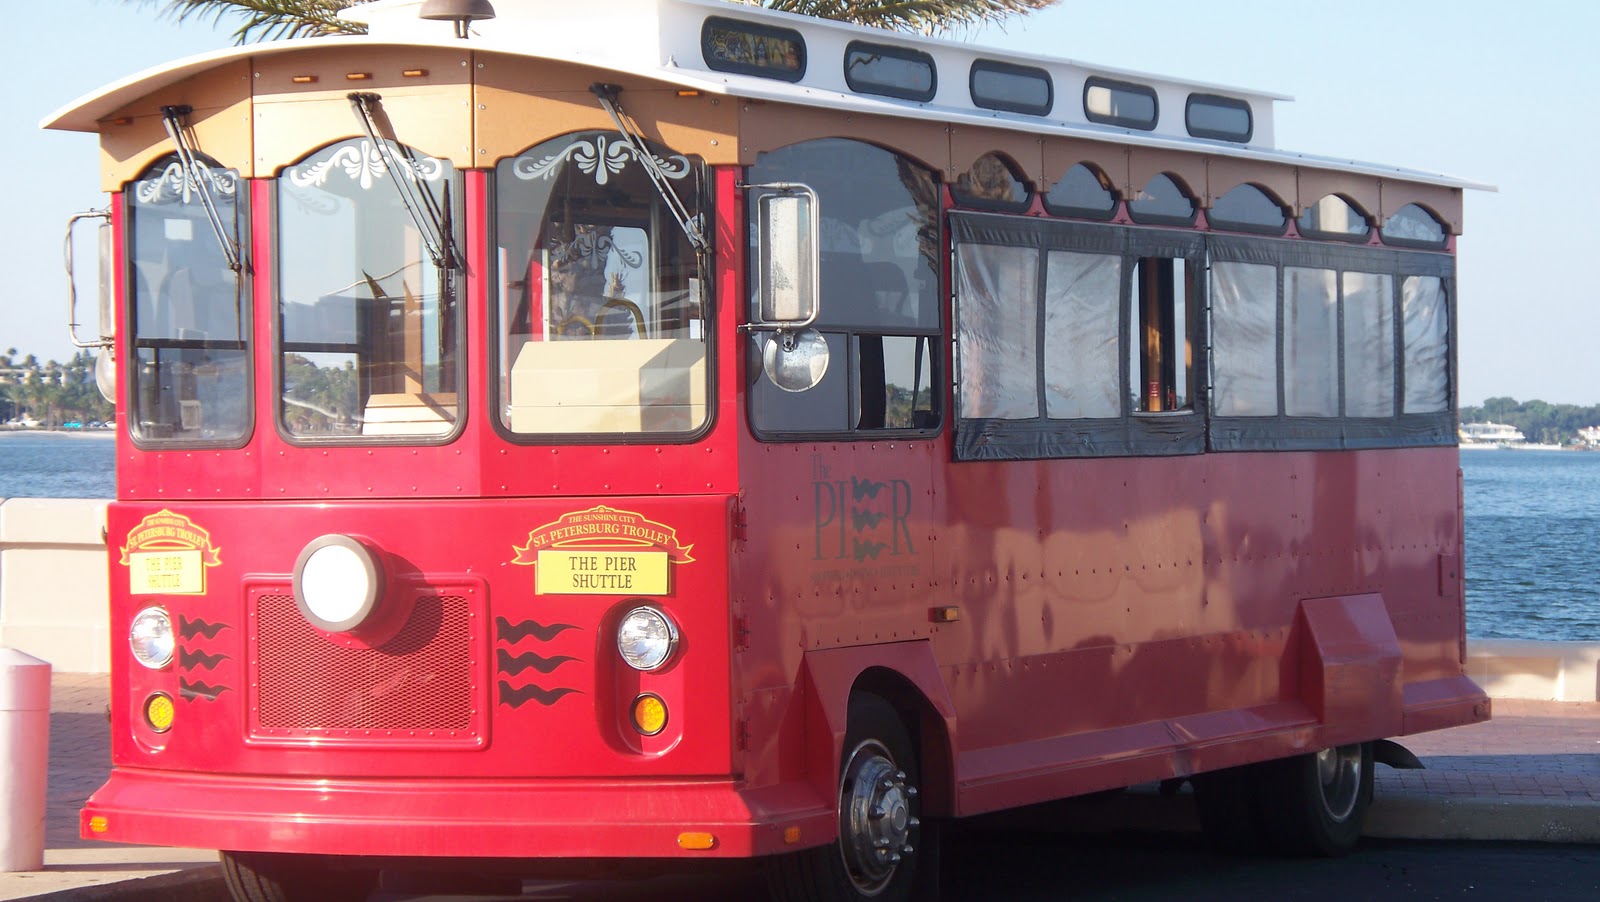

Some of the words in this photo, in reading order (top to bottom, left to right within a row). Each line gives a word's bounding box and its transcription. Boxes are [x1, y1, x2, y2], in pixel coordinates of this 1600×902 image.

[568, 516, 583, 524] THE
[583, 514, 618, 522] SUNSHINE
[618, 515, 636, 524] CITY
[138, 526, 176, 543] PETERSBURG
[176, 528, 206, 548] TROLLEY
[533, 535, 549, 548] ST.
[550, 523, 620, 542] PETERSBURG
[622, 524, 671, 545] TROLLEY
[145, 557, 161, 571] THE
[164, 556, 183, 571] PIER
[568, 556, 598, 571] THE
[604, 556, 637, 572] PIER
[148, 574, 181, 588] SHUTTLE
[572, 573, 633, 589] SHUTTLE
